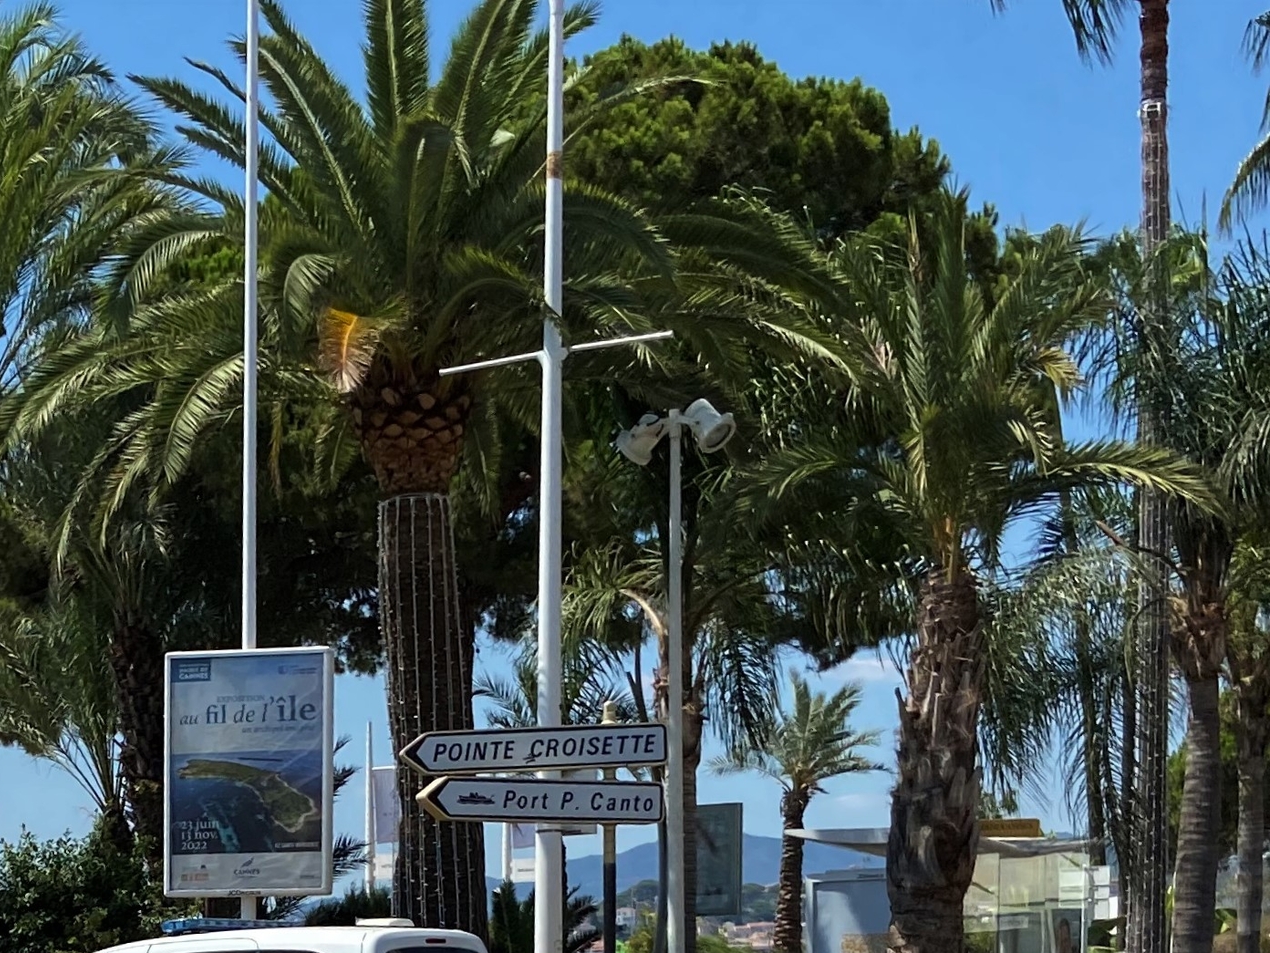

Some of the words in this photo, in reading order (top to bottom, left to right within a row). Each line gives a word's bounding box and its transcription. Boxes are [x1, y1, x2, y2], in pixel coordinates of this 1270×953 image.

[179, 714, 199, 725] au
[206, 704, 226, 724] fil
[233, 704, 255, 724] de
[433, 740, 515, 763] POINTE
[531, 734, 657, 758] CROISETTE
[503, 790, 548, 810] Port
[561, 791, 579, 811] P.
[591, 793, 654, 812] Canto
[181, 821, 193, 830] 23
[181, 832, 191, 841] 13
[181, 841, 207, 850] 2022
